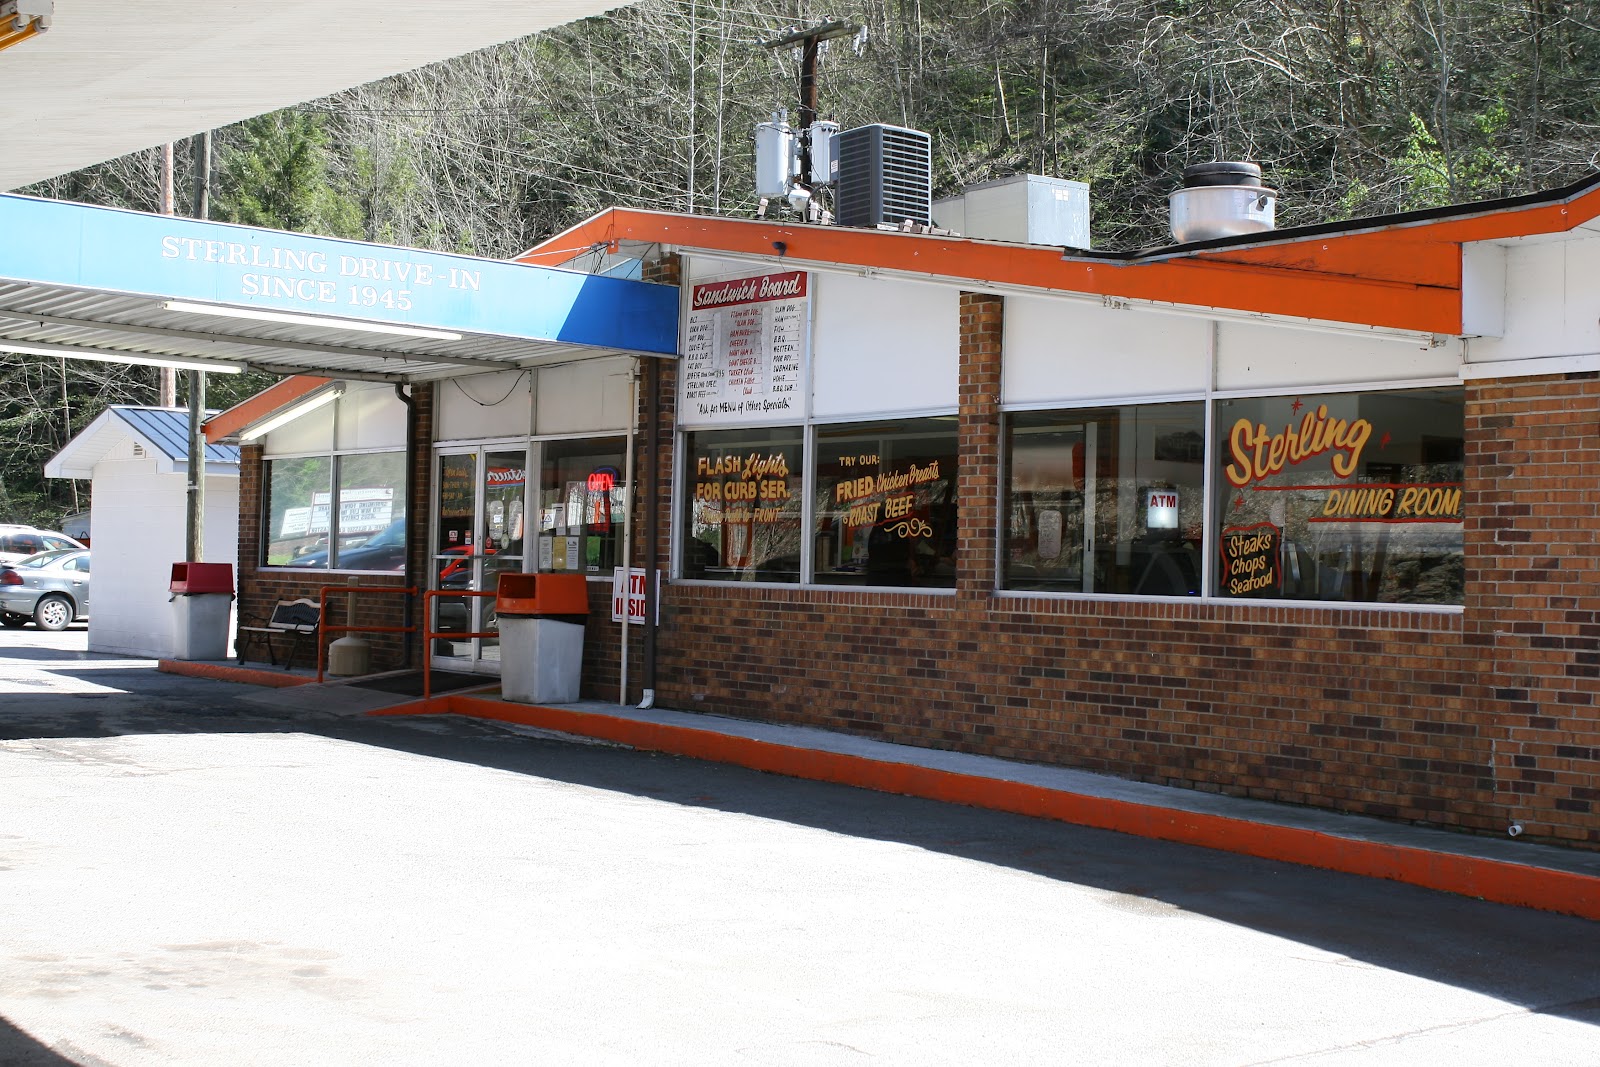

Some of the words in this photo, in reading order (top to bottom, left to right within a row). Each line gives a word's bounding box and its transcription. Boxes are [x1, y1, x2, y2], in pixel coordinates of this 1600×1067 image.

[162, 235, 328, 273] STERLING
[339, 255, 481, 292] DRIVE-IN
[241, 273, 337, 303] SINCE
[348, 285, 413, 311] 1945
[694, 279, 757, 307] Sandwich
[759, 273, 801, 298] Board
[719, 402, 737, 413] MENU
[839, 456, 856, 467] TRY
[860, 454, 880, 466] OUR:
[1225, 404, 1372, 489] Sterling
[697, 455, 741, 476] FLASH
[741, 452, 789, 480] Lights
[587, 473, 614, 491] OPEN
[696, 482, 720, 501] FOR
[724, 481, 757, 500] CURB
[760, 480, 791, 499] SER.
[836, 475, 874, 503] FRIED
[876, 469, 909, 492] Chicken
[909, 460, 940, 485] Breasts
[848, 503, 880, 527] ROAST
[885, 495, 914, 518] BEEF
[1150, 494, 1176, 508] ATM
[1322, 487, 1394, 516] DINING
[1398, 486, 1463, 516] ROOM
[1228, 532, 1272, 558] Steaks
[1231, 555, 1266, 578] Chops
[1230, 567, 1273, 595] Seafood
[615, 597, 646, 617] ISID
